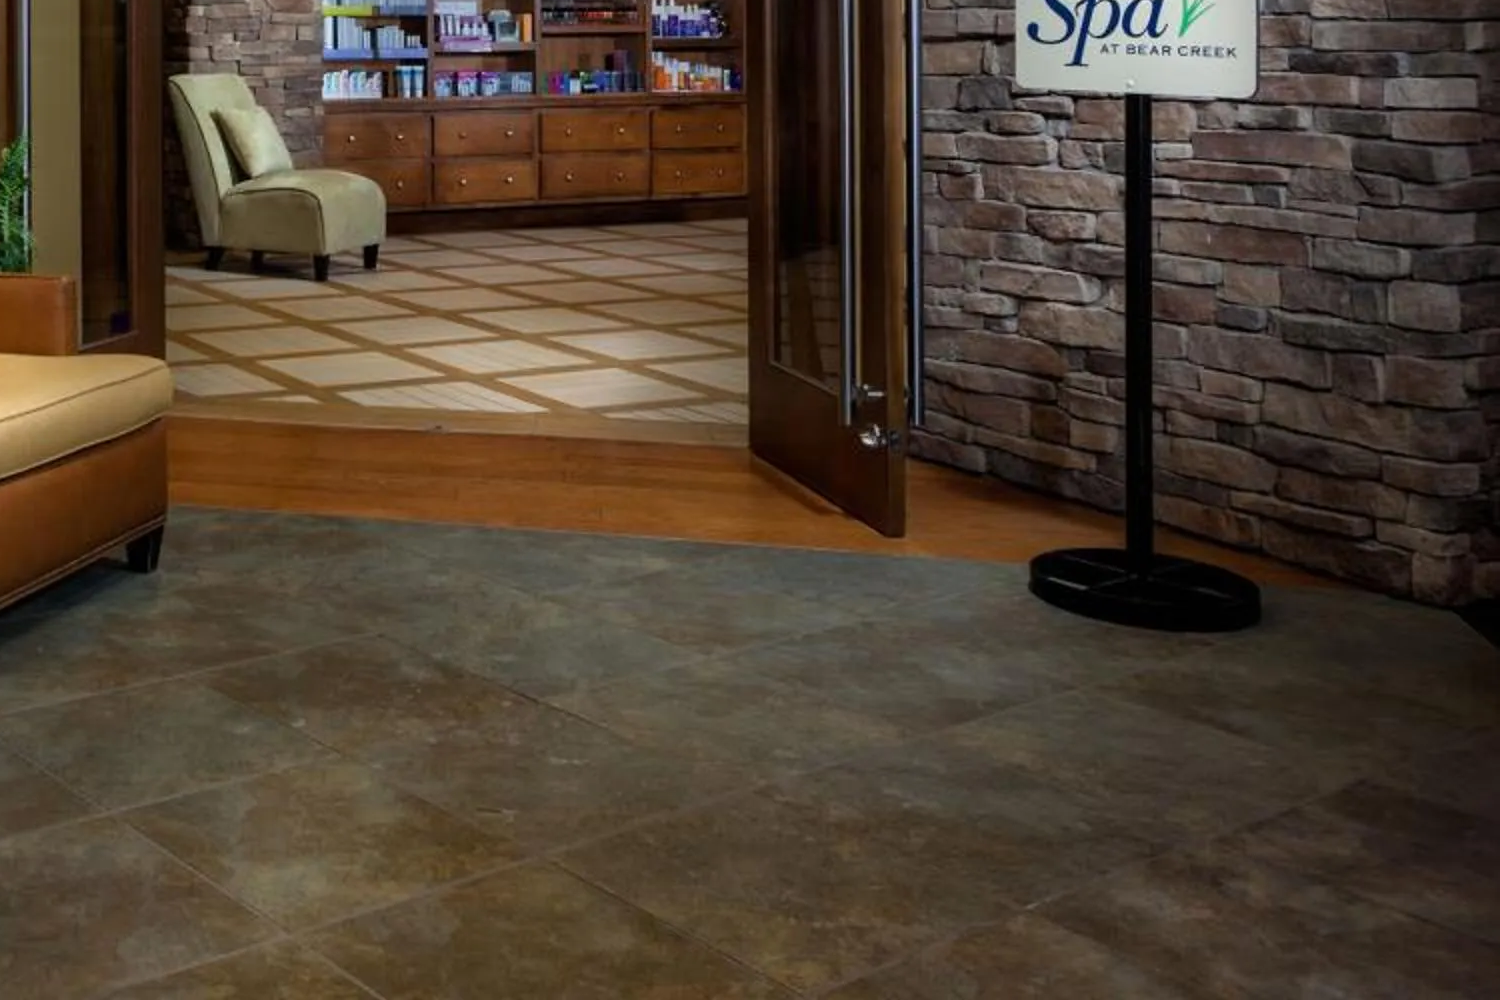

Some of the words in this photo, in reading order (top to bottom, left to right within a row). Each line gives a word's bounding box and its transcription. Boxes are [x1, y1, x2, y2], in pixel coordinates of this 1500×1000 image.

[1099, 43, 1120, 55] AT
[1125, 43, 1172, 57] BEAR
[1177, 45, 1238, 59] CREEK
